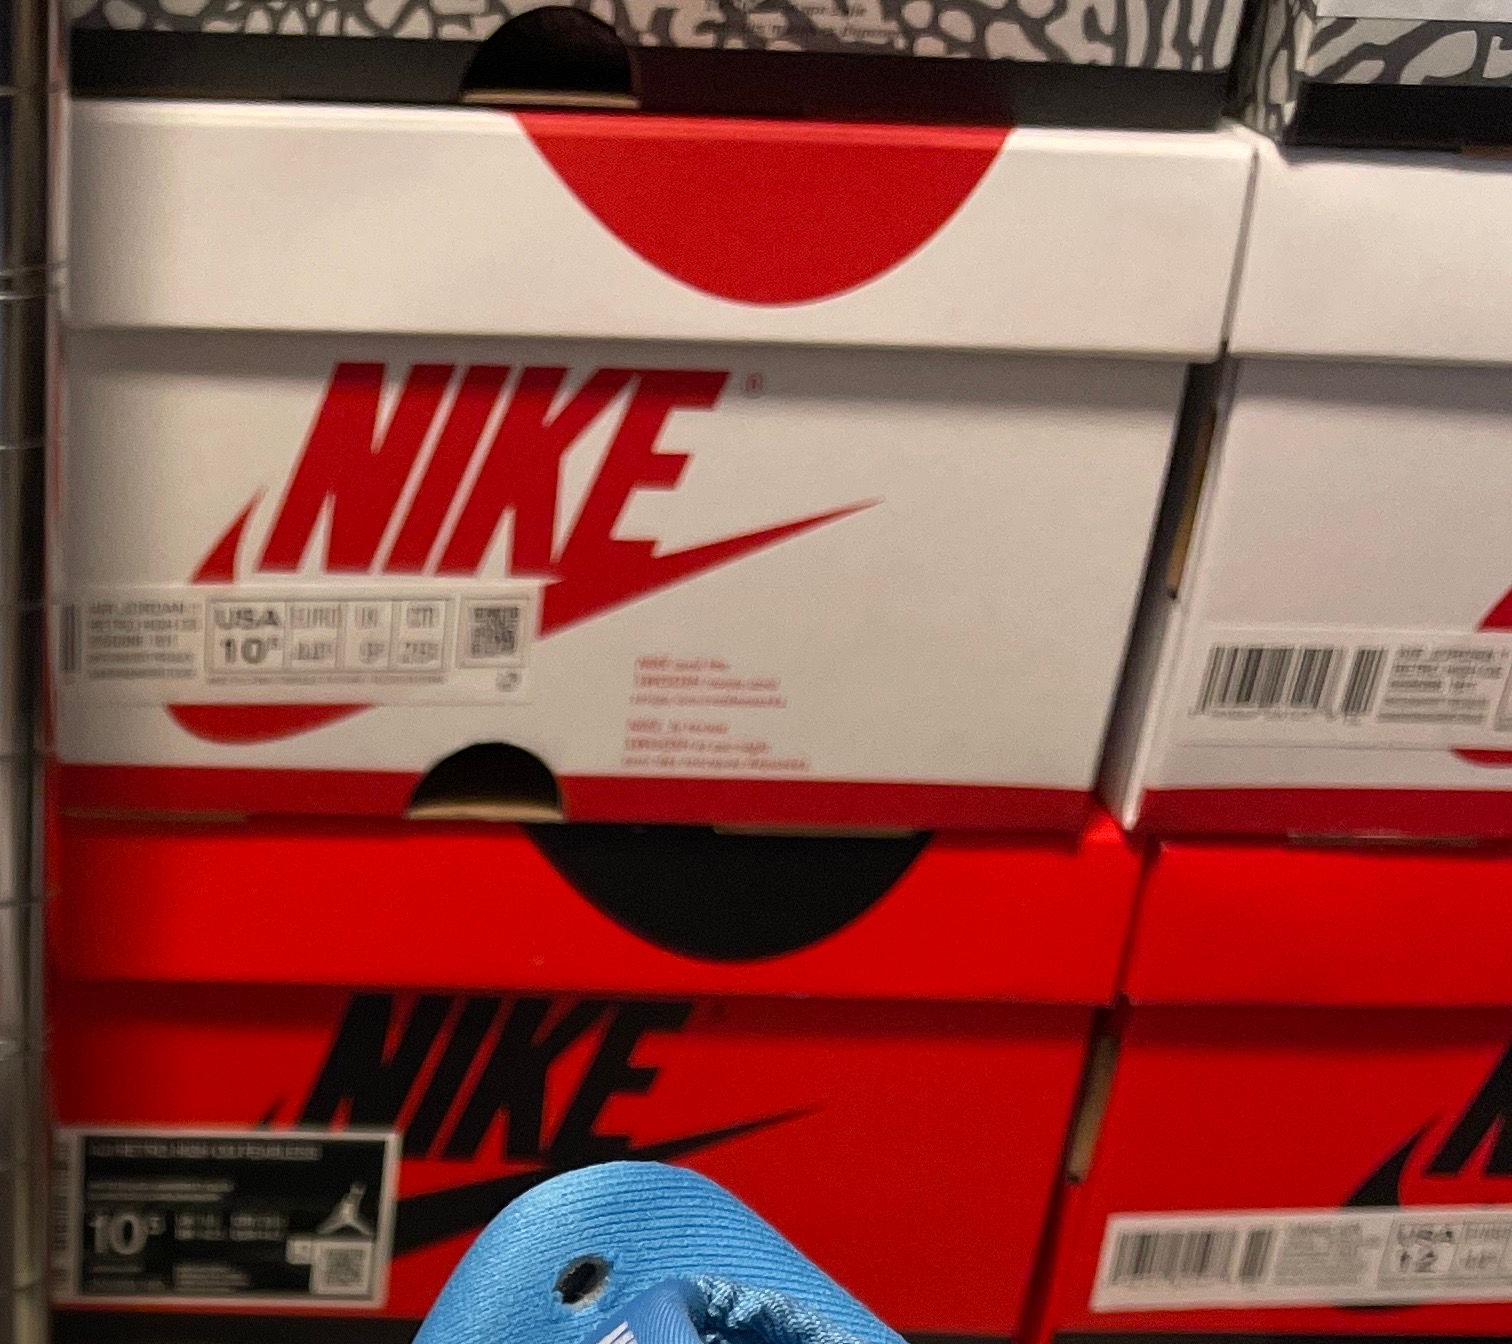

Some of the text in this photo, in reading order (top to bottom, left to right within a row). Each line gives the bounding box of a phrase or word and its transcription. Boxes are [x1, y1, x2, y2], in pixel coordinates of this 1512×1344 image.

[253, 361, 731, 578] NIKE
[214, 608, 281, 630] USA
[296, 993, 693, 1160] NIKE
